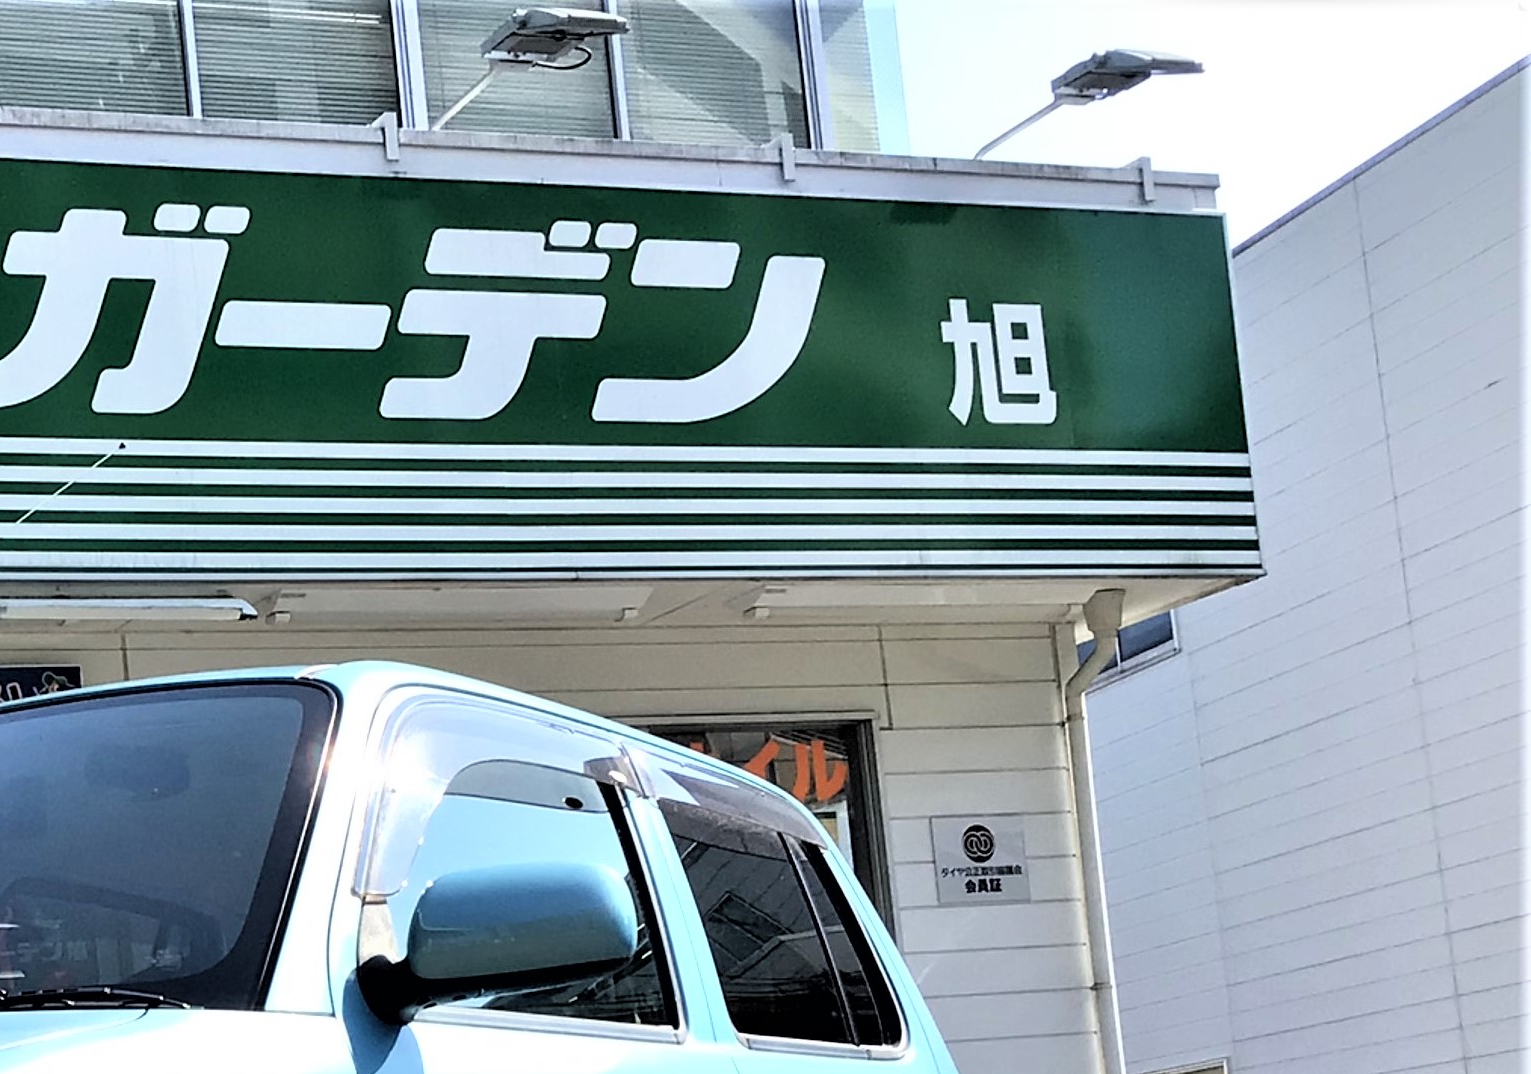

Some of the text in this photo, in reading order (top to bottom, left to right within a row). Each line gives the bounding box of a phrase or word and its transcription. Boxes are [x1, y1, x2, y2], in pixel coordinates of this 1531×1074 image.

[940, 297, 1057, 426] 旭
[965, 878, 1002, 893] 会員証
